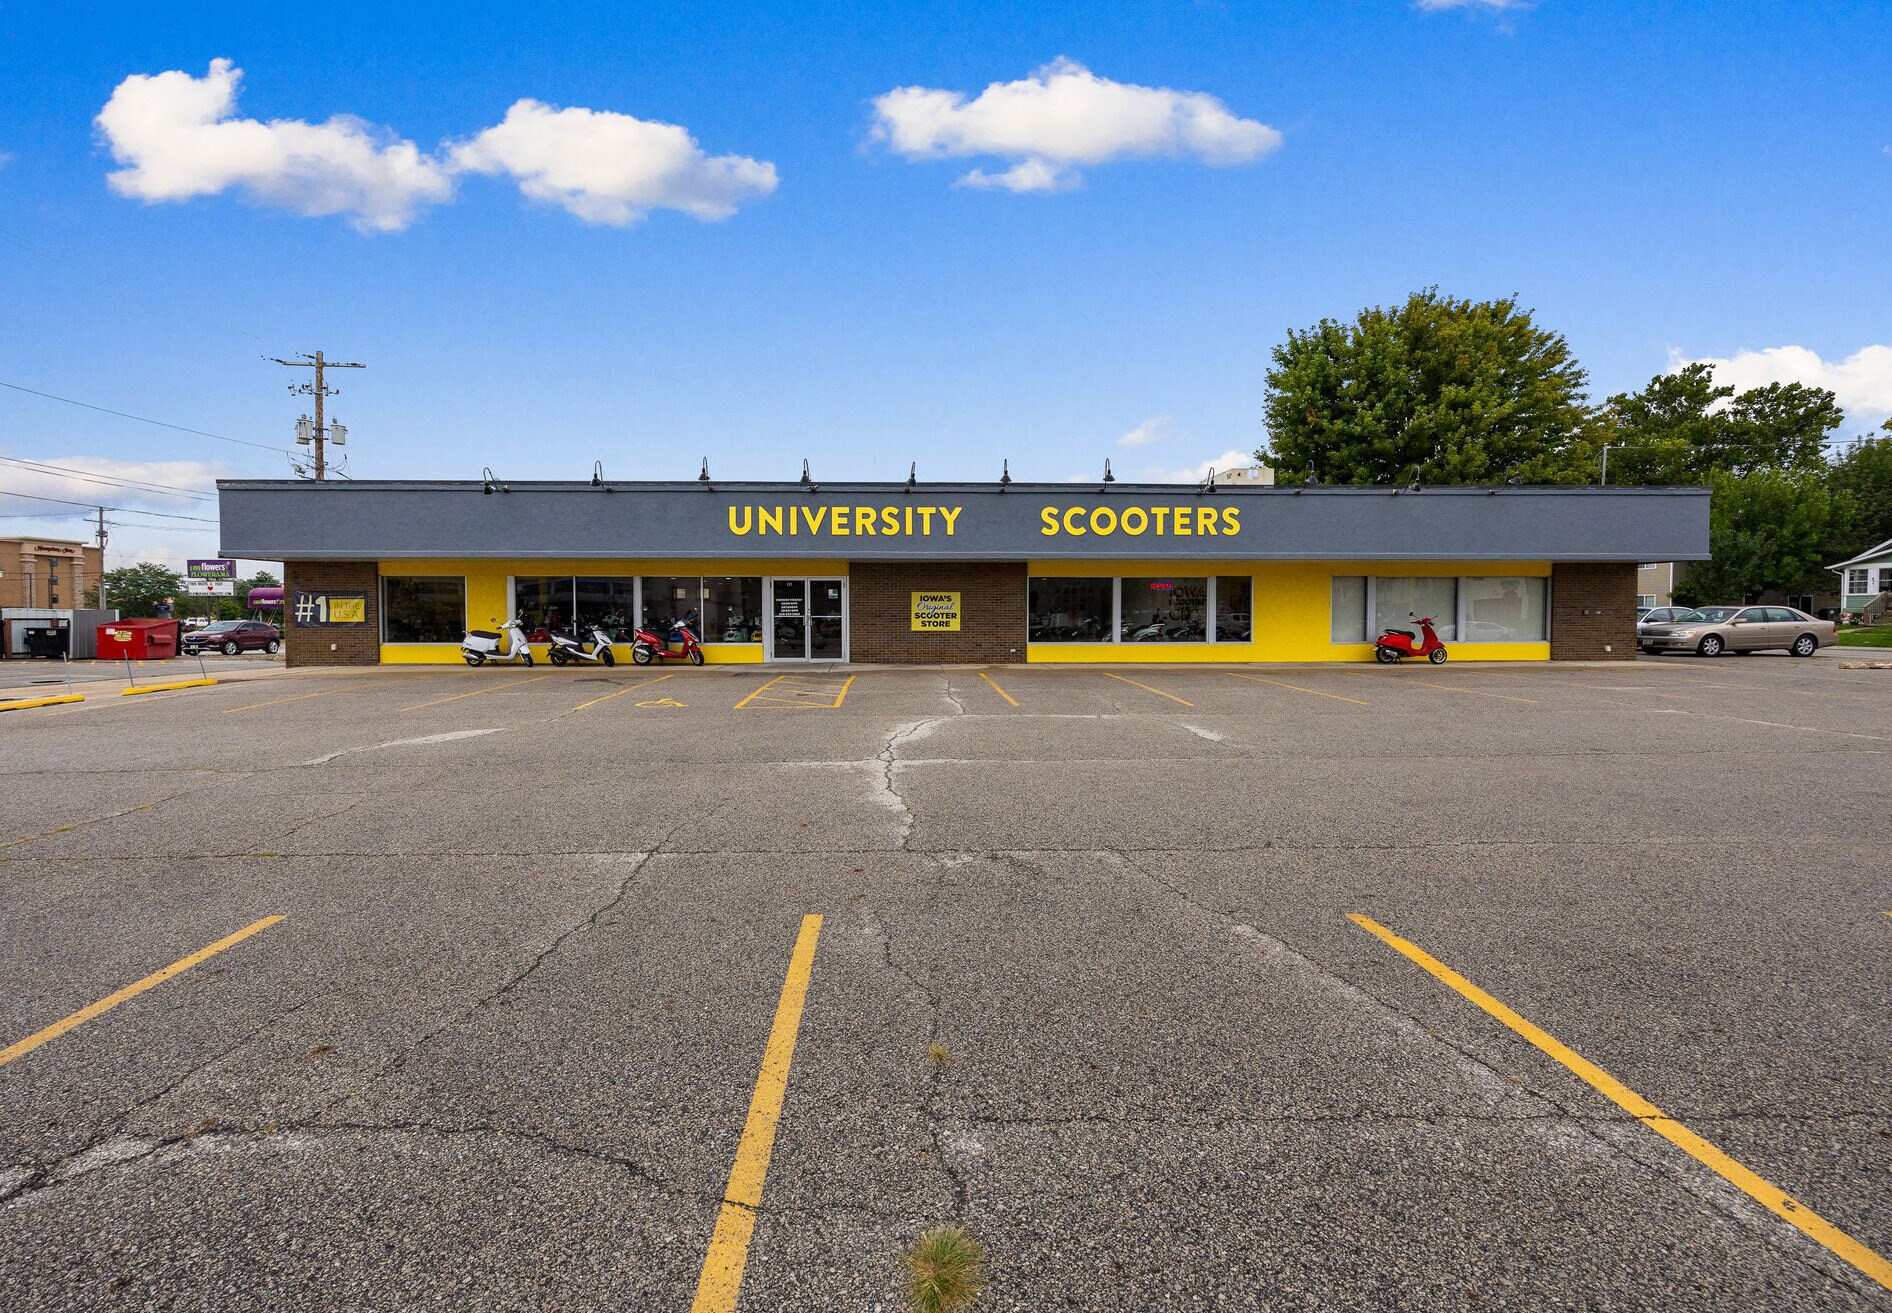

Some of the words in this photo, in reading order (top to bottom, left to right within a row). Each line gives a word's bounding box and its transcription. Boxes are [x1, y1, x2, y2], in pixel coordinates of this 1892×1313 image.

[728, 505, 963, 537] UNIVERSITY
[1040, 505, 1241, 537] SCOOTERS
[919, 594, 952, 603] IOWA'S
[294, 594, 327, 623] #1
[333, 602, 343, 610] IN
[344, 602, 360, 610] THE
[916, 601, 956, 614] Original
[914, 612, 958, 620] SCOOTER
[920, 620, 951, 628] STORE
